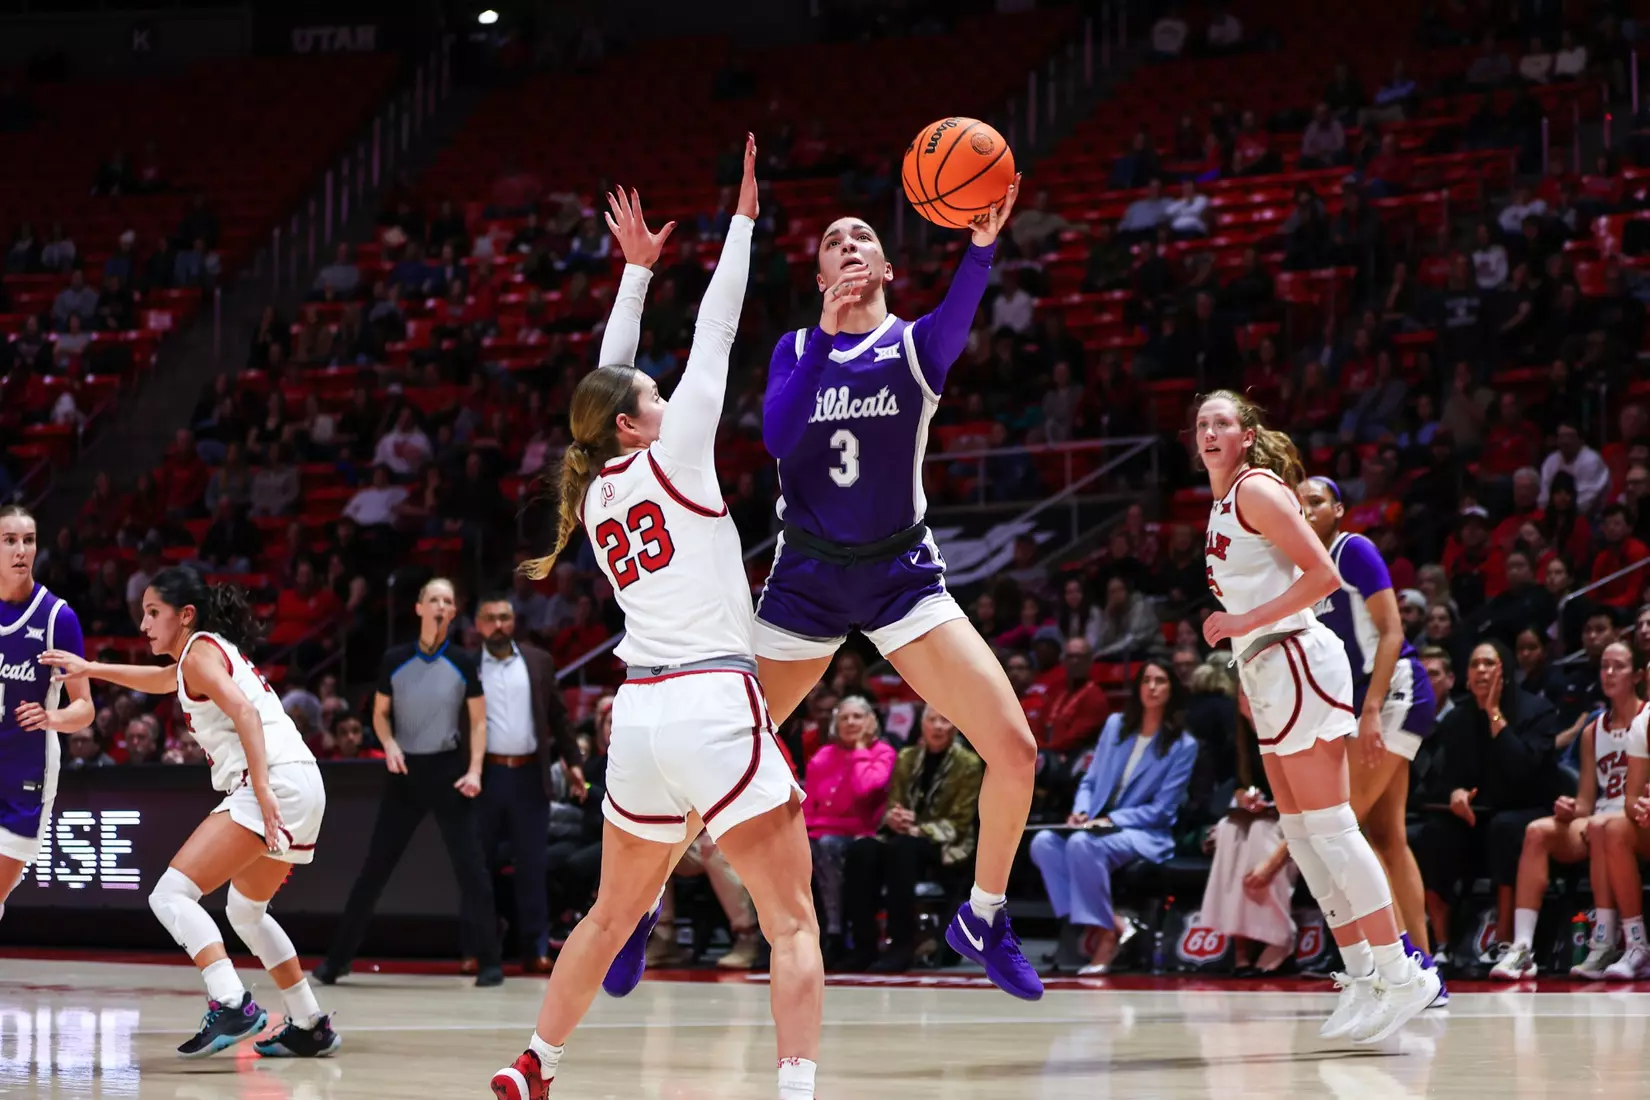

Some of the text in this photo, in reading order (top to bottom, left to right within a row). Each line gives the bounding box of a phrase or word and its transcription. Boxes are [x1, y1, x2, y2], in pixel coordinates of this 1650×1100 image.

[132, 28, 152, 52] K
[291, 25, 378, 53] UTAH
[924, 117, 961, 154] ilson
[808, 385, 900, 424] ildcats
[829, 428, 860, 488] 3
[596, 499, 675, 592] 23
[0, 652, 37, 682] cats
[1607, 774, 1627, 799] 2
[21, 810, 141, 889] ISE
[1188, 931, 1218, 951] 66
[1301, 930, 1317, 951] 6
